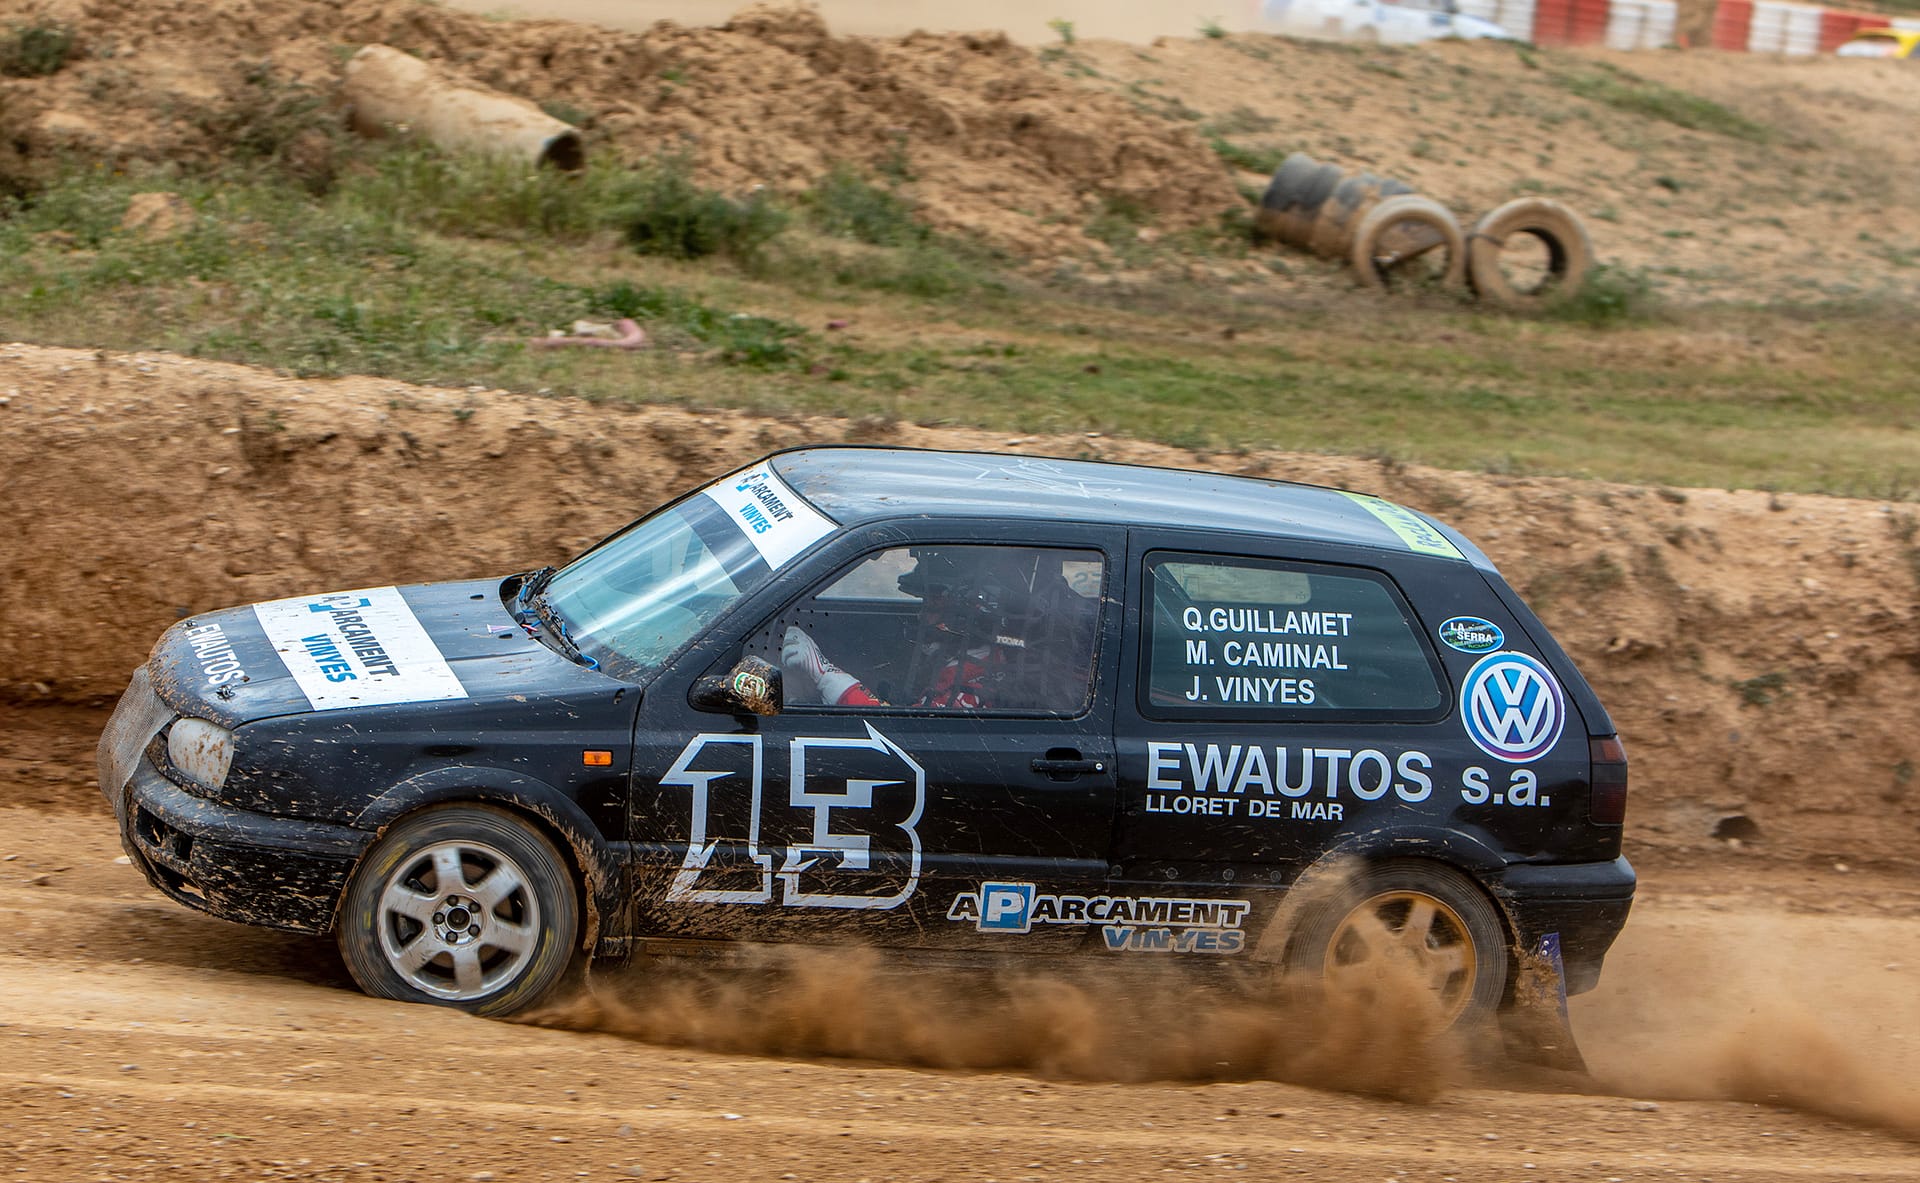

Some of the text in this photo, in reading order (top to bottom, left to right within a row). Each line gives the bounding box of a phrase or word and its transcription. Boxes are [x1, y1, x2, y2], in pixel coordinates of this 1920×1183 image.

[739, 502, 772, 534] VINYES
[1183, 607, 1352, 636] Q.GUILLAMET
[1450, 622, 1465, 632] LA
[1457, 631, 1494, 643] SERRA
[185, 623, 245, 684] EWAUTOS
[301, 633, 357, 683] VINYES
[1185, 640, 1348, 670] M. CAMINAL
[1185, 676, 1315, 704] J. VINYES
[1146, 741, 1551, 807] EWAUTOS s.a.
[1145, 794, 1344, 821] LLORET DE MAR
[948, 884, 1249, 930] APARCAMENT
[1104, 926, 1246, 953] VINYES
